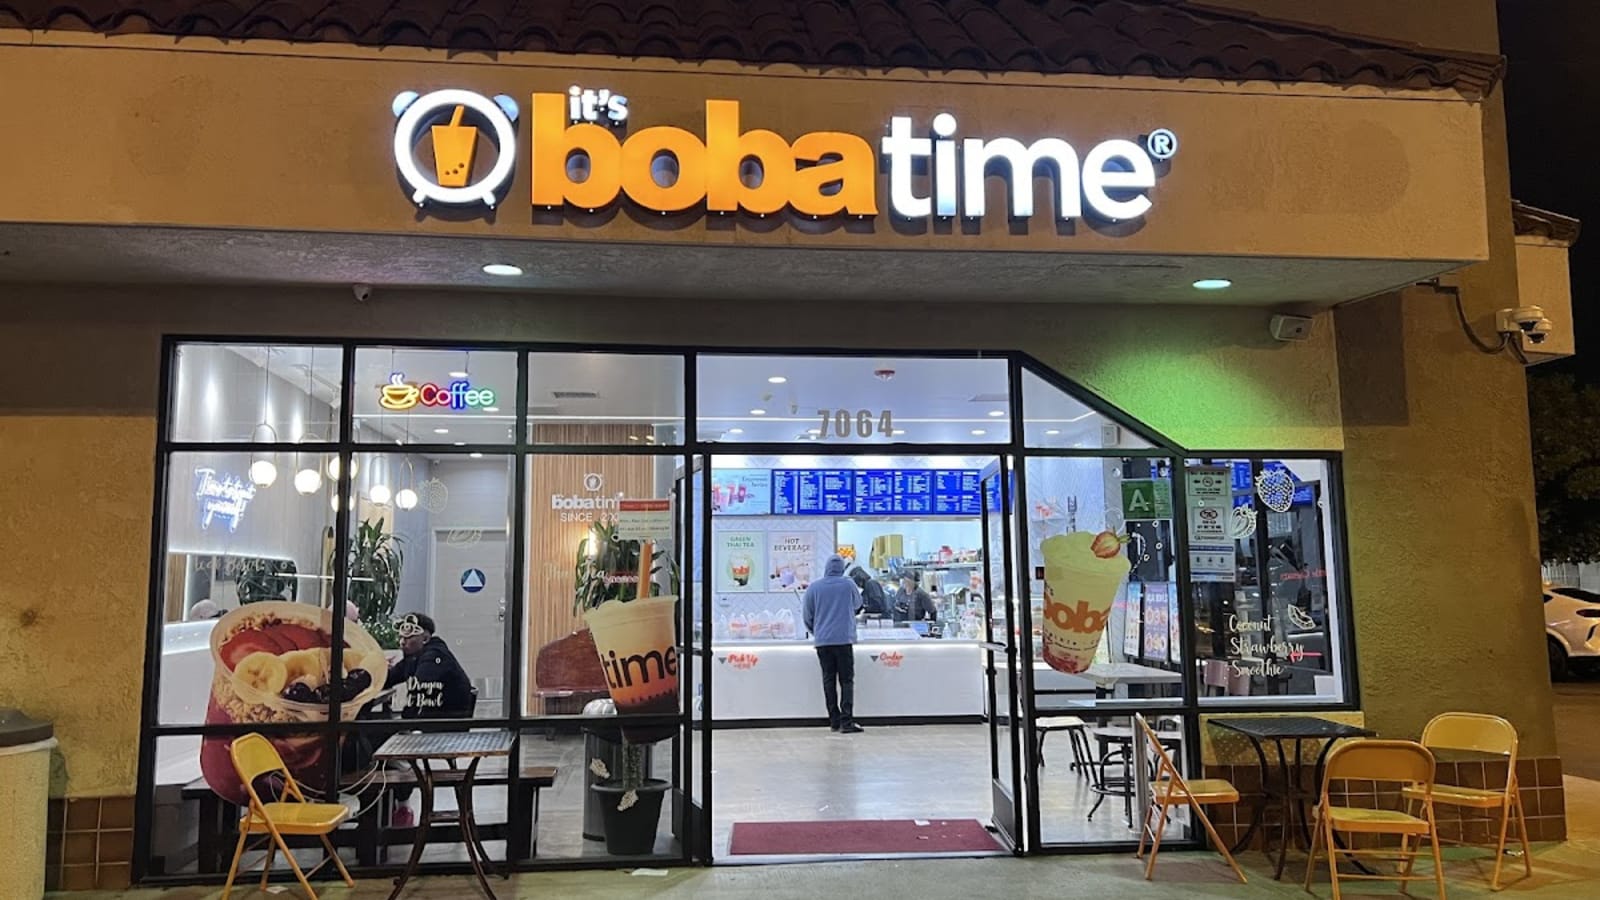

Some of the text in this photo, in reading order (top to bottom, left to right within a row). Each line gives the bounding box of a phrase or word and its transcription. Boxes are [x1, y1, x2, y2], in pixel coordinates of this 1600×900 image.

[568, 85, 629, 120] it's
[420, 380, 495, 410] Coffee
[817, 408, 893, 438] 7064
[1128, 488, 1149, 511] A
[560, 512, 593, 522] SINCE
[774, 544, 810, 552] BEVERAGE
[1229, 614, 1271, 632] Coconut
[1230, 635, 1304, 662] Strawberry
[600, 646, 677, 689] time
[1231, 658, 1283, 677] Smoothie
[407, 676, 443, 695] Dragon
